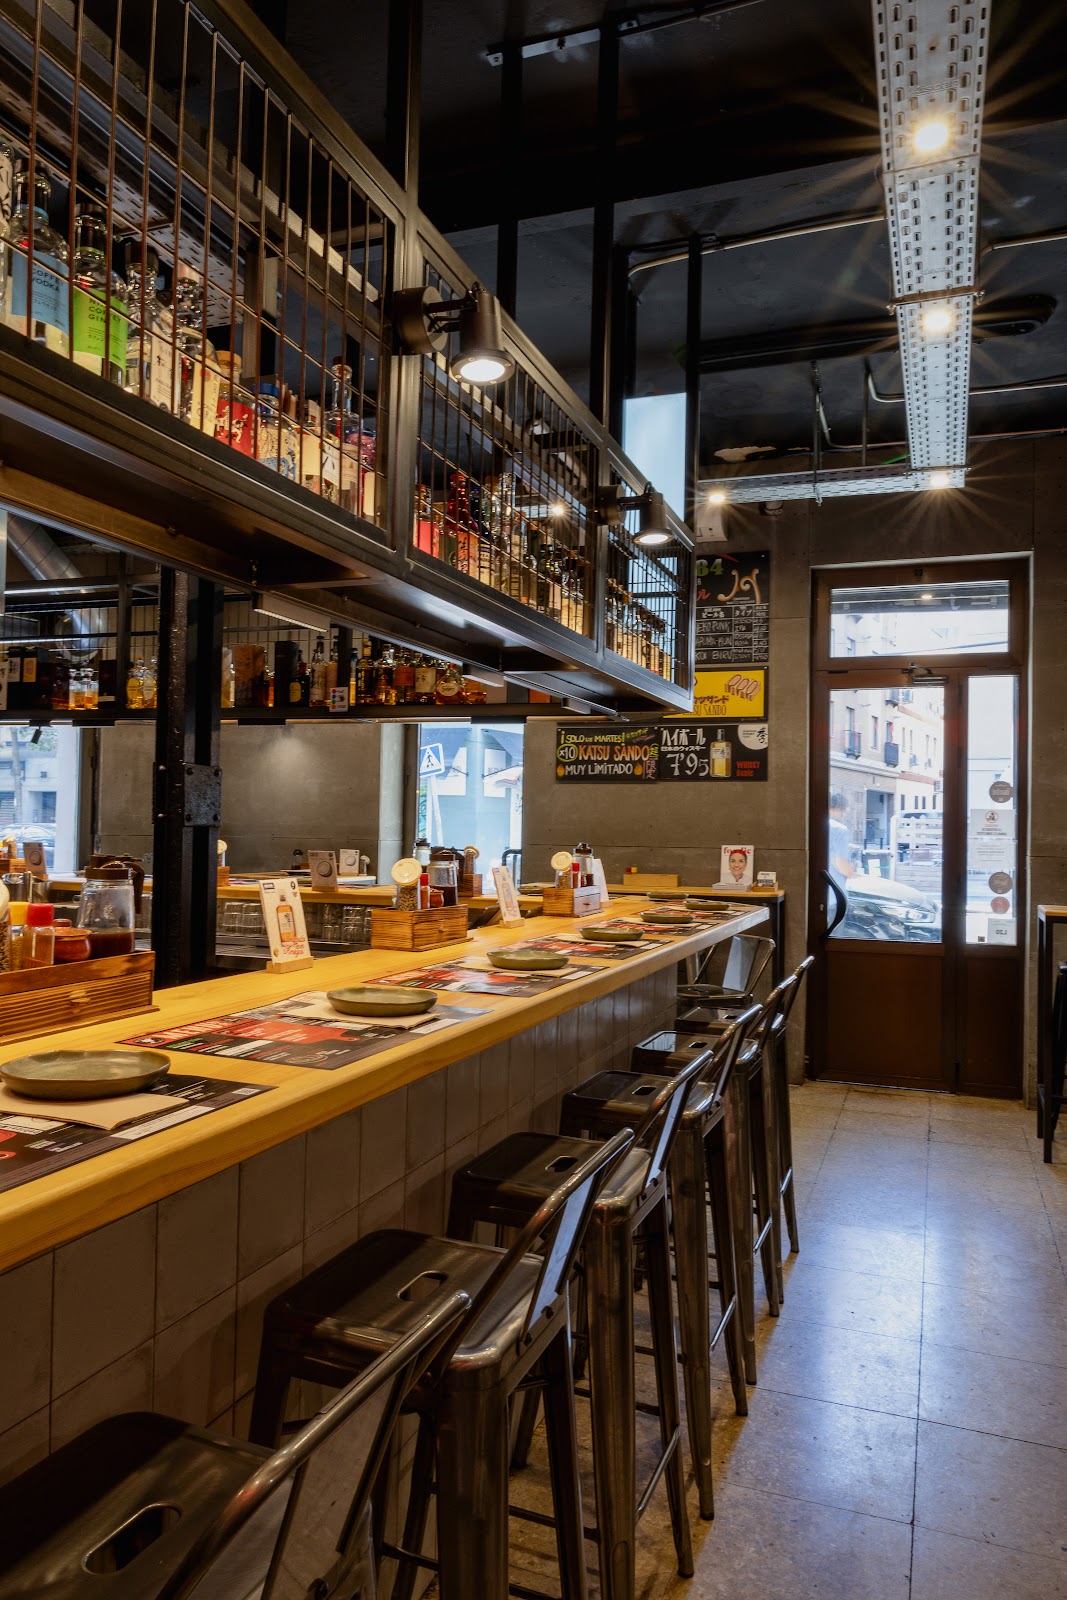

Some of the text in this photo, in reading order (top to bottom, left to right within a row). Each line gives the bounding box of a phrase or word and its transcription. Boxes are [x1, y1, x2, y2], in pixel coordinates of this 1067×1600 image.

[88, 305, 121, 322] COFEY
[704, 704, 727, 716] SANDO
[578, 745, 650, 761] KATSU SANDO
[565, 764, 586, 775] MUY
